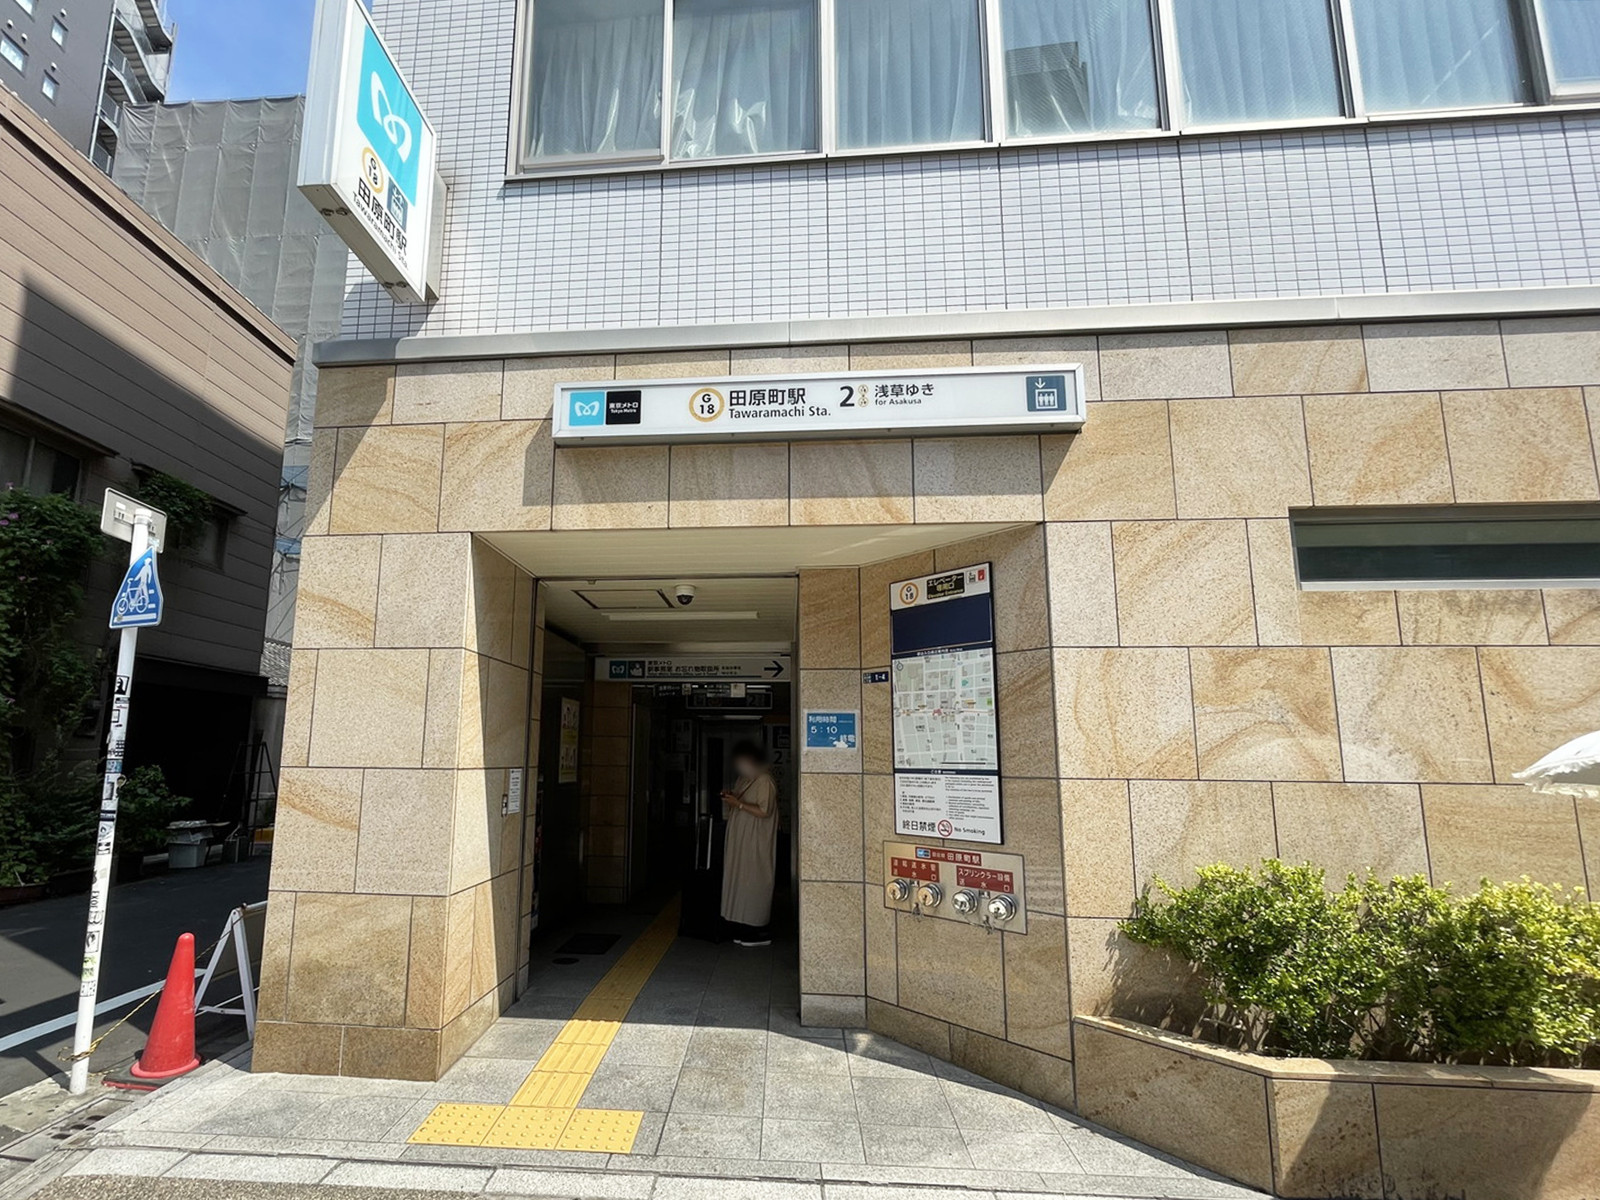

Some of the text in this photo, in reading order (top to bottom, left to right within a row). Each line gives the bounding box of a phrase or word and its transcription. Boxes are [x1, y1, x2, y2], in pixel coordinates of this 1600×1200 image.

[353, 191, 397, 254] Tawaramachi
[358, 177, 407, 256] 田原町駅
[702, 393, 712, 403] G
[729, 387, 806, 406] 田原町駅
[839, 385, 855, 407] 2
[874, 383, 934, 398] 浅草ゆき
[875, 398, 887, 406] for
[699, 404, 715, 415] 18
[729, 405, 831, 419] Tawaramachi Sta.
[928, 575, 963, 586] エレベーター
[905, 592, 914, 600] 18
[902, 820, 936, 832] 終日禁煙
[962, 827, 986, 836] Smoking
[947, 852, 980, 864] 田原町駅
[958, 867, 1010, 882] スプリンクラー設備
